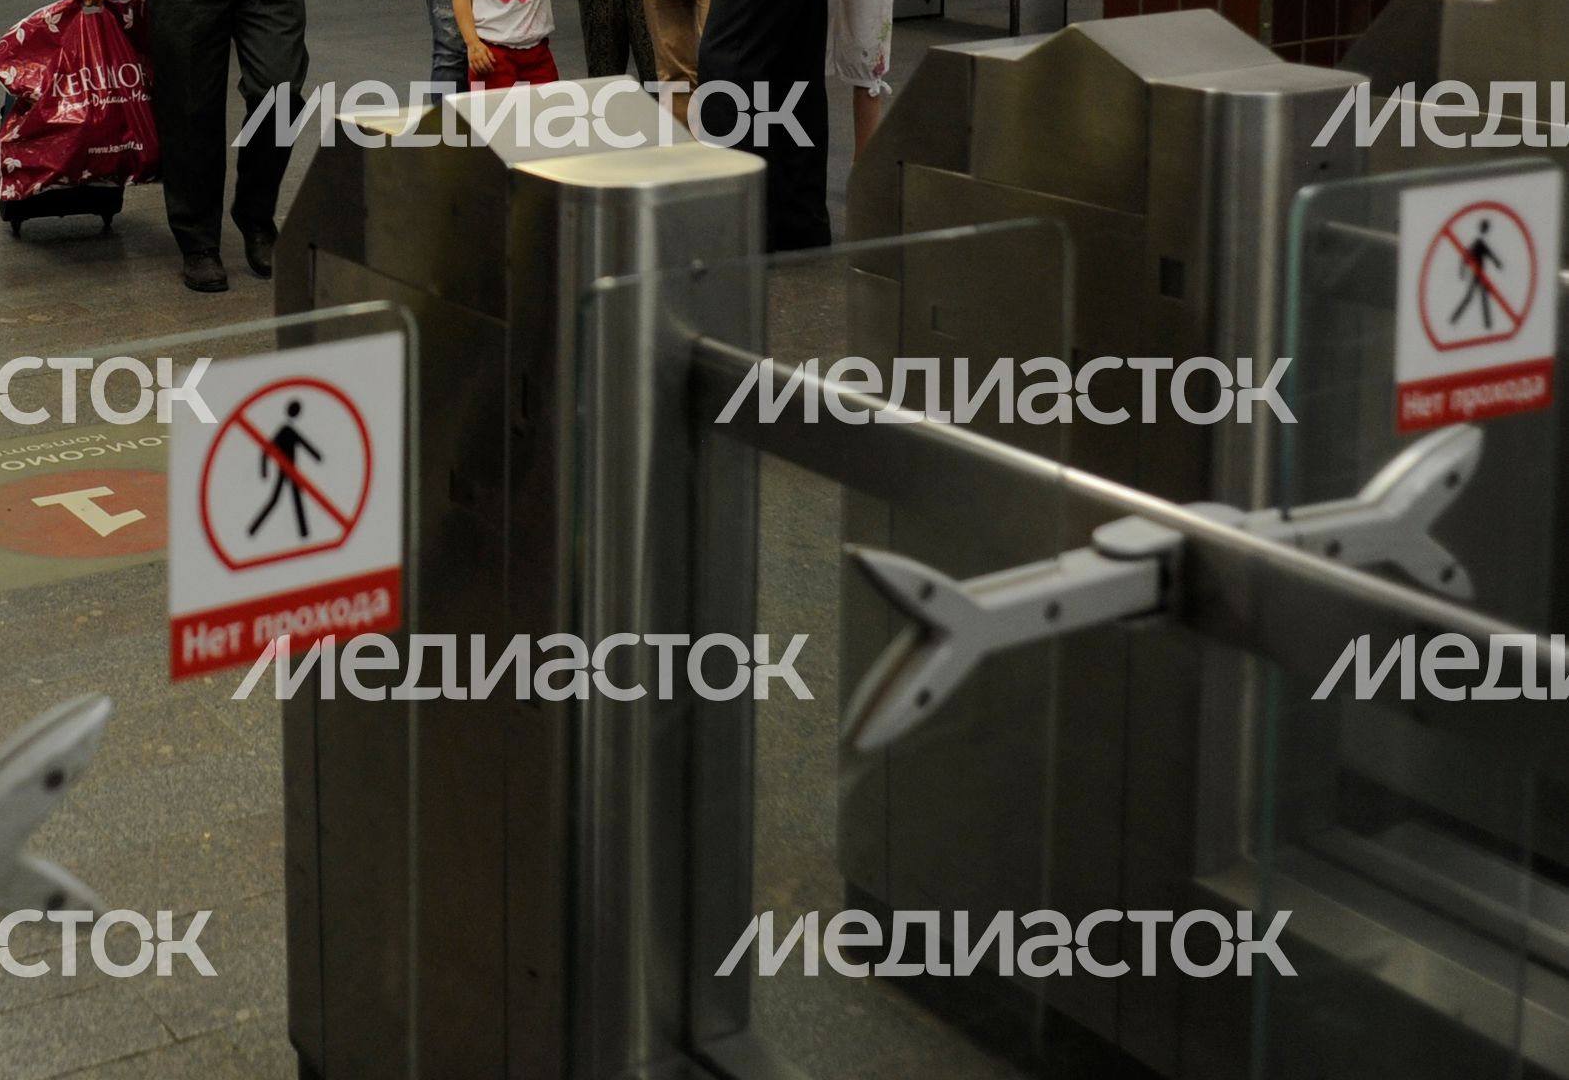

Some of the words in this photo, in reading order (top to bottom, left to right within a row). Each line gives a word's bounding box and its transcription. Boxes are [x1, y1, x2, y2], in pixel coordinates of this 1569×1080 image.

[1401, 389, 1445, 421] Нет
[1448, 374, 1546, 416] прохода
[30, 485, 147, 538] 1
[181, 620, 243, 665] Нет
[252, 587, 392, 648] прохода
